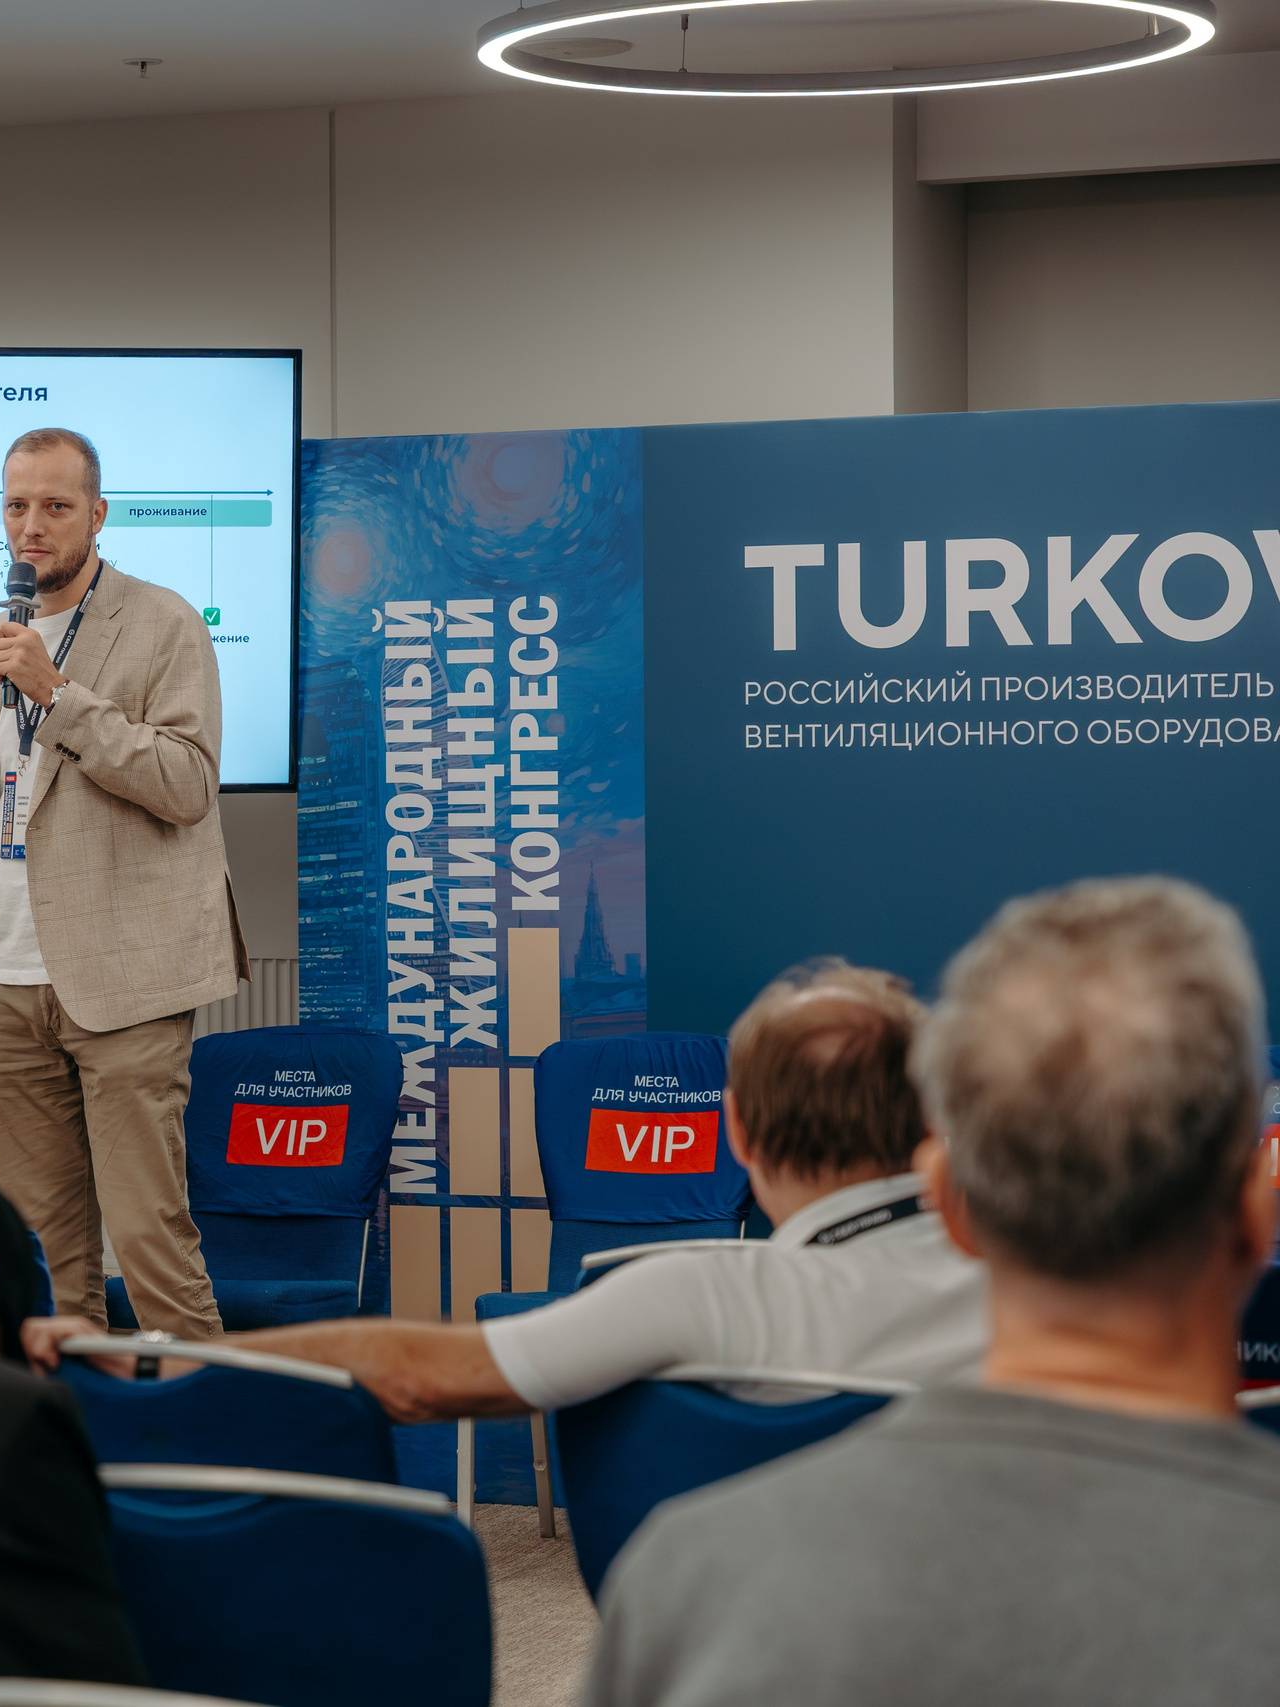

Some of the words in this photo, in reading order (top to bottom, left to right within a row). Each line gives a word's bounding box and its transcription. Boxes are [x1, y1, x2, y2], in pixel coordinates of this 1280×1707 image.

[129, 507, 208, 519] проживание
[211, 635, 250, 643] жение
[745, 670, 972, 706] РОССИЙСКИЙ
[981, 672, 1275, 704] ПРОИЗВОДИТЕЛЬ
[745, 719, 1079, 751] ВЕНТИЛЯЦИОННОГО
[508, 595, 560, 911] КОНГРЕСС
[433, 598, 505, 1049] ЖИЛИЩНЫЙ
[371, 600, 445, 1194] МЕЖДУНАРОДНЫЙ
[234, 1083, 265, 1096] ДЛЯ
[268, 1084, 352, 1098] УЧАСТНИКОВ
[274, 1070, 316, 1083] МЕСТА
[634, 1075, 679, 1087] МЕСТА
[591, 1088, 624, 1102] ДЛЯ
[628, 1090, 721, 1104] УЧАСТНИКОВ
[256, 1118, 327, 1156] VIP
[616, 1123, 695, 1163] VIP
